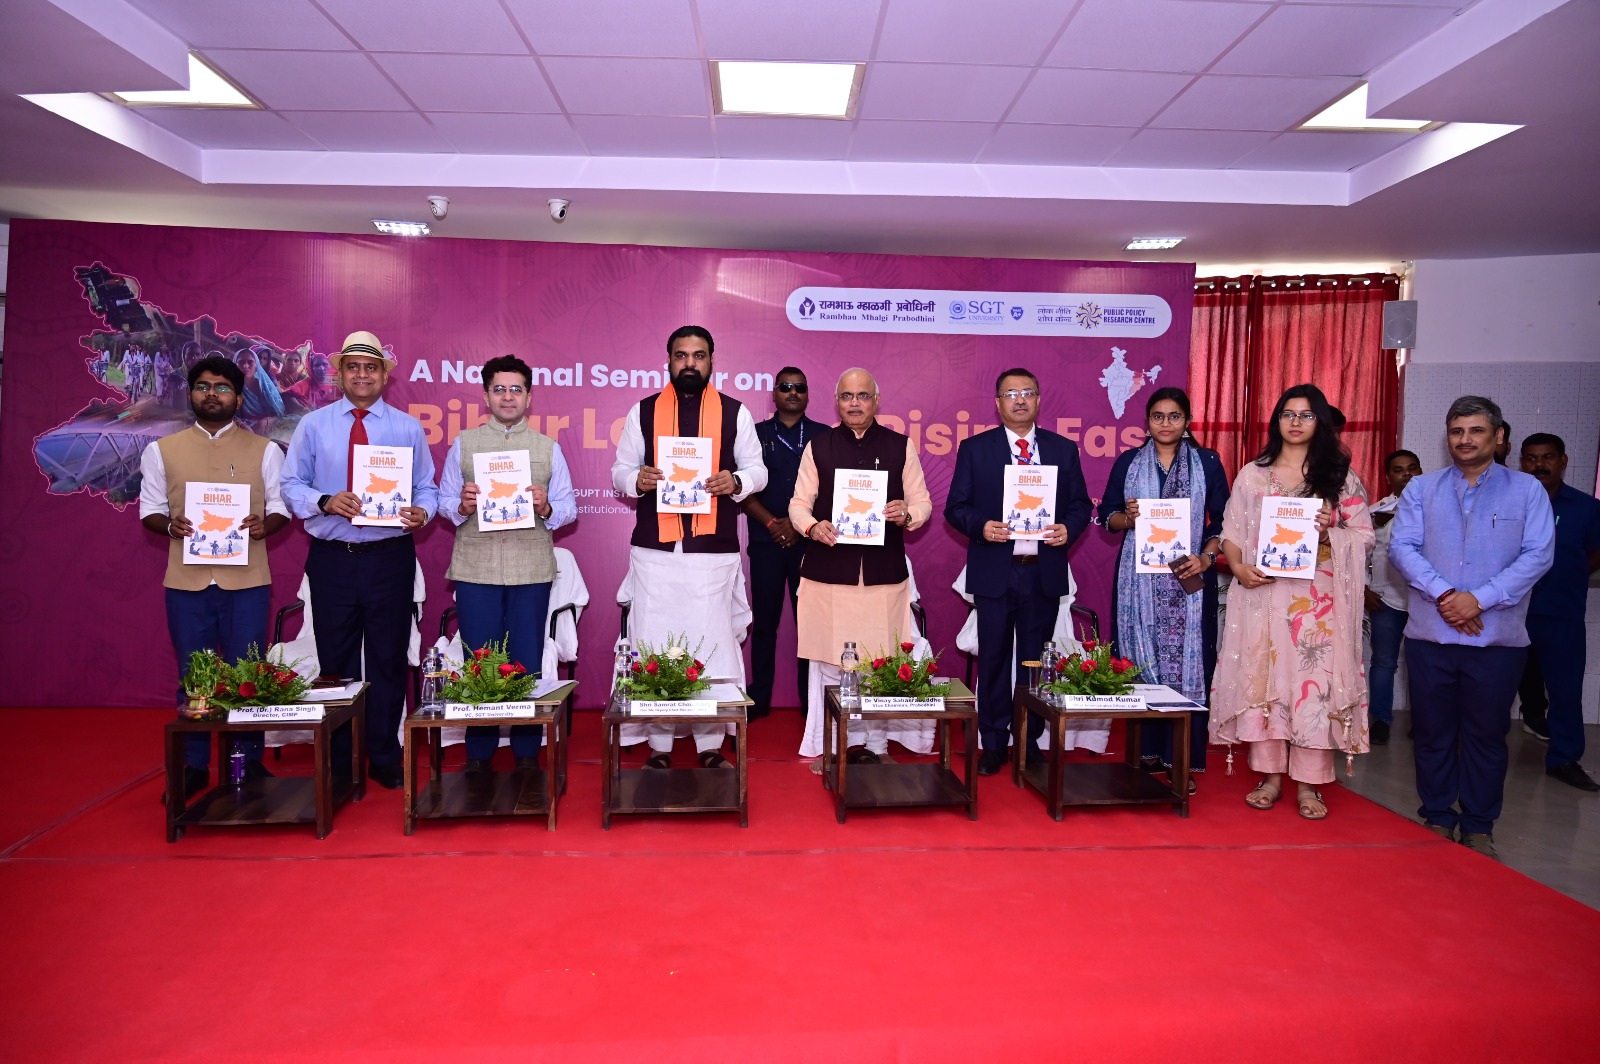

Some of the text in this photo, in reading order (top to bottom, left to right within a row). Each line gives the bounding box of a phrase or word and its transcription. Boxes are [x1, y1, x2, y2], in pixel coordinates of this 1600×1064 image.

[819, 300, 854, 311] रामभाऊ
[896, 299, 936, 312] प्रबोधिनी
[968, 300, 1005, 314] SGT
[1103, 308, 1124, 316] PUBLIC
[819, 313, 935, 322] Rambhau Mhalgi Prabodhini
[409, 359, 774, 392] A Nanal Semir on
[1056, 417, 1147, 459] Eas
[672, 446, 697, 456] BIHAR
[370, 456, 396, 466] BIHAR
[489, 461, 514, 472] BIHAR
[848, 479, 873, 489] BIHAR
[1018, 475, 1042, 484] BIHAR
[203, 493, 232, 503] BIHAR
[578, 504, 631, 514] stitutional
[1150, 508, 1175, 517] BIHAR
[1276, 507, 1304, 517] BIHAR
